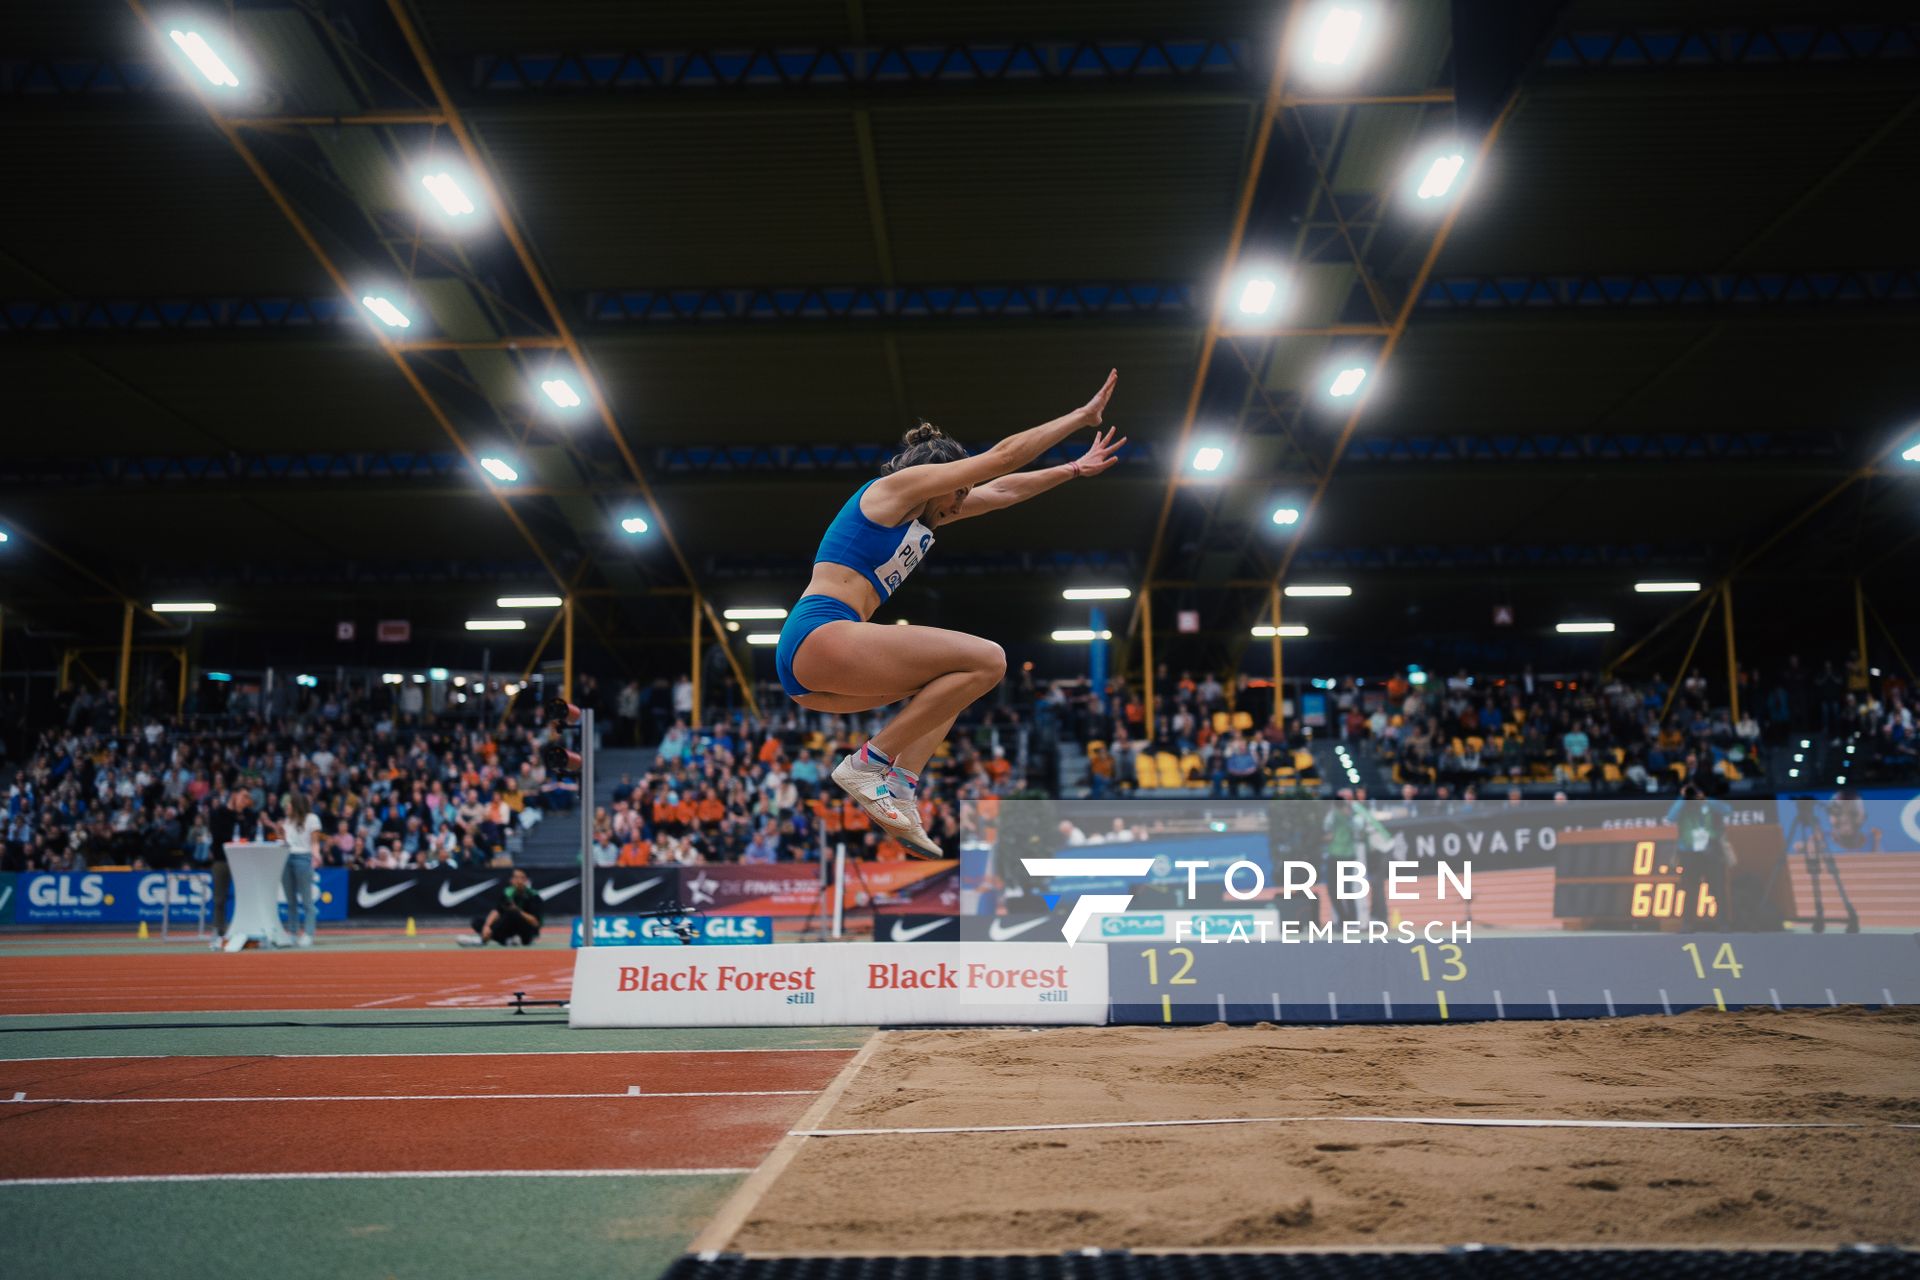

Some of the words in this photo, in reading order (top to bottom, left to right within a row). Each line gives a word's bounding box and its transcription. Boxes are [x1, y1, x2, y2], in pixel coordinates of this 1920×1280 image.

[1140, 947, 1197, 985] 12
[1410, 944, 1468, 982] 13
[1681, 941, 1744, 979] 14
[617, 965, 708, 992] Black
[716, 966, 816, 991] Forest
[867, 963, 958, 989] Black
[966, 963, 1068, 989] Forest
[786, 992, 815, 1004] still
[1039, 990, 1068, 1002] still
